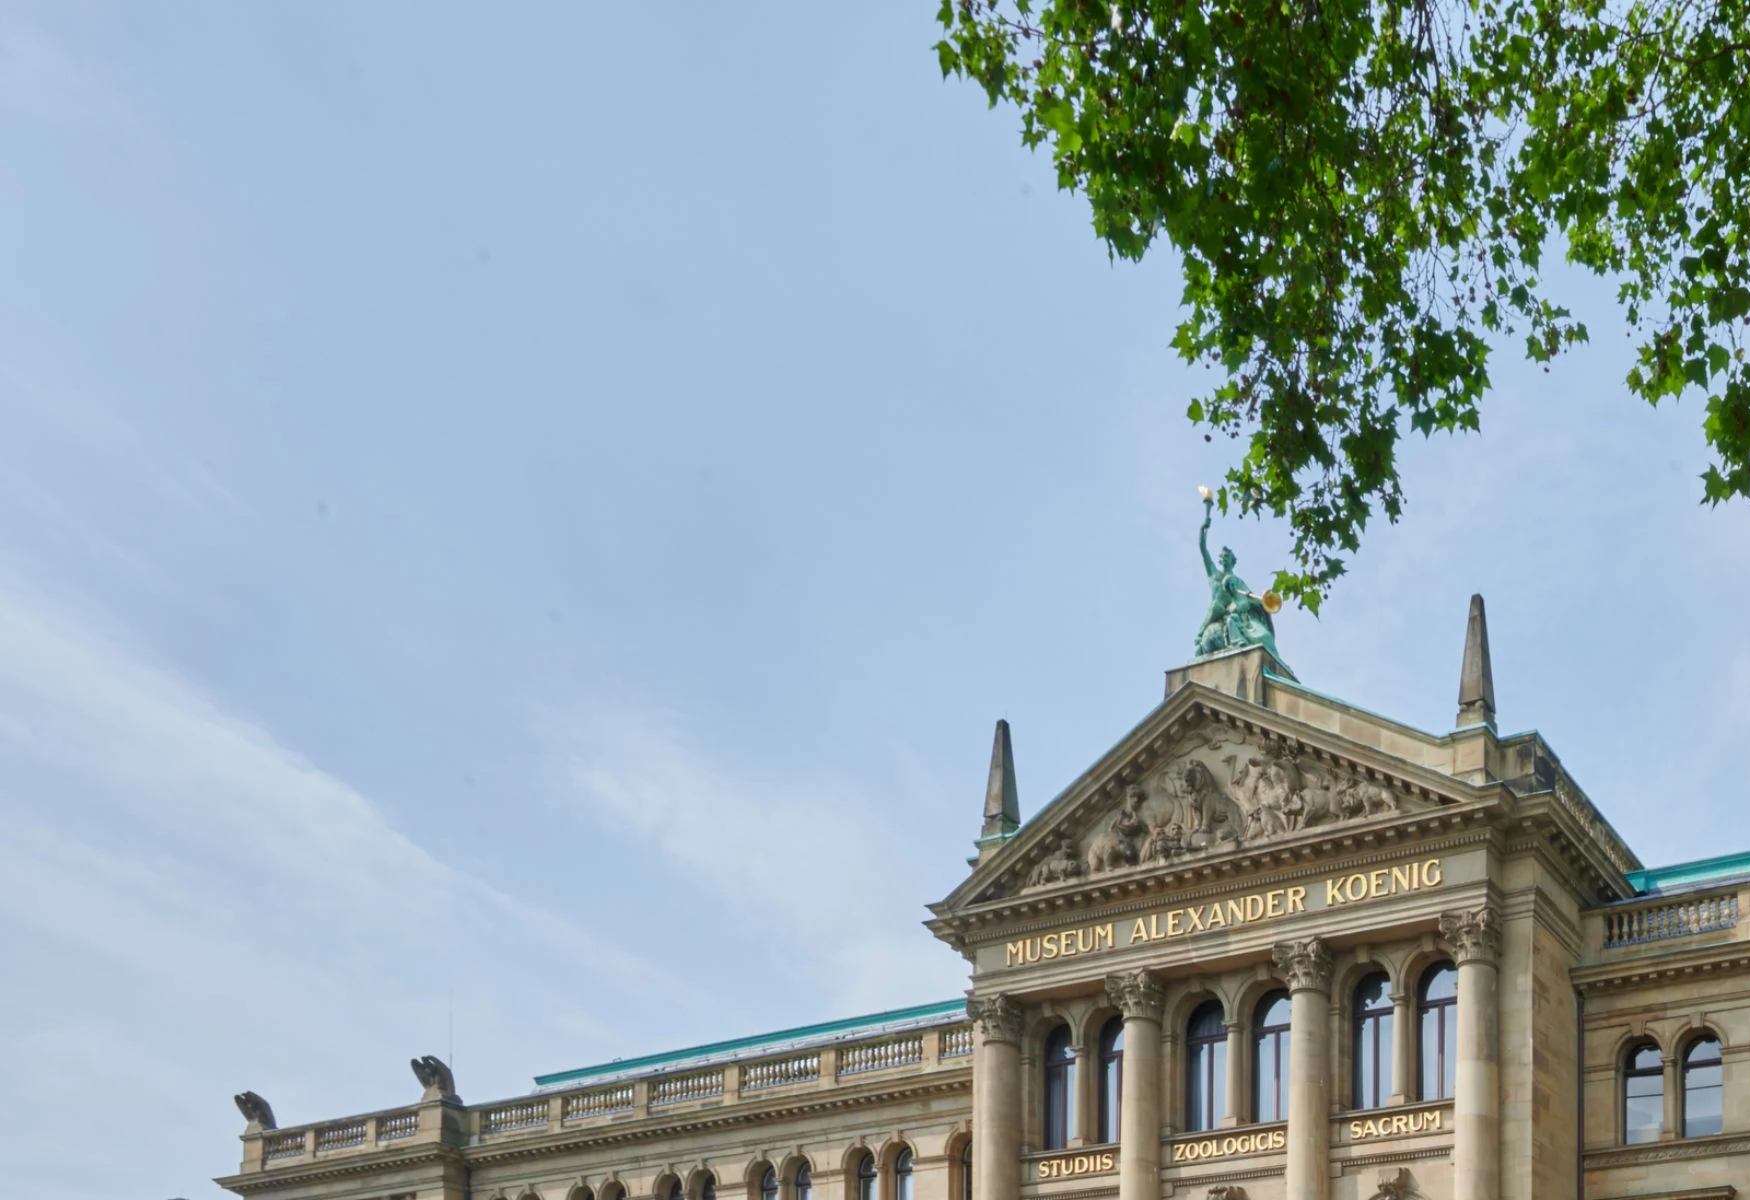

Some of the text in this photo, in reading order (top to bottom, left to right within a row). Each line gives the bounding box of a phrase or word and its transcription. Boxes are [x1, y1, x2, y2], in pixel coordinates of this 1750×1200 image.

[1006, 859, 1442, 966] MUSEUM ALEXANDER KOENIG
[1038, 1110, 1441, 1178] STUDIIS ZOOLOGICIS SACRUM
